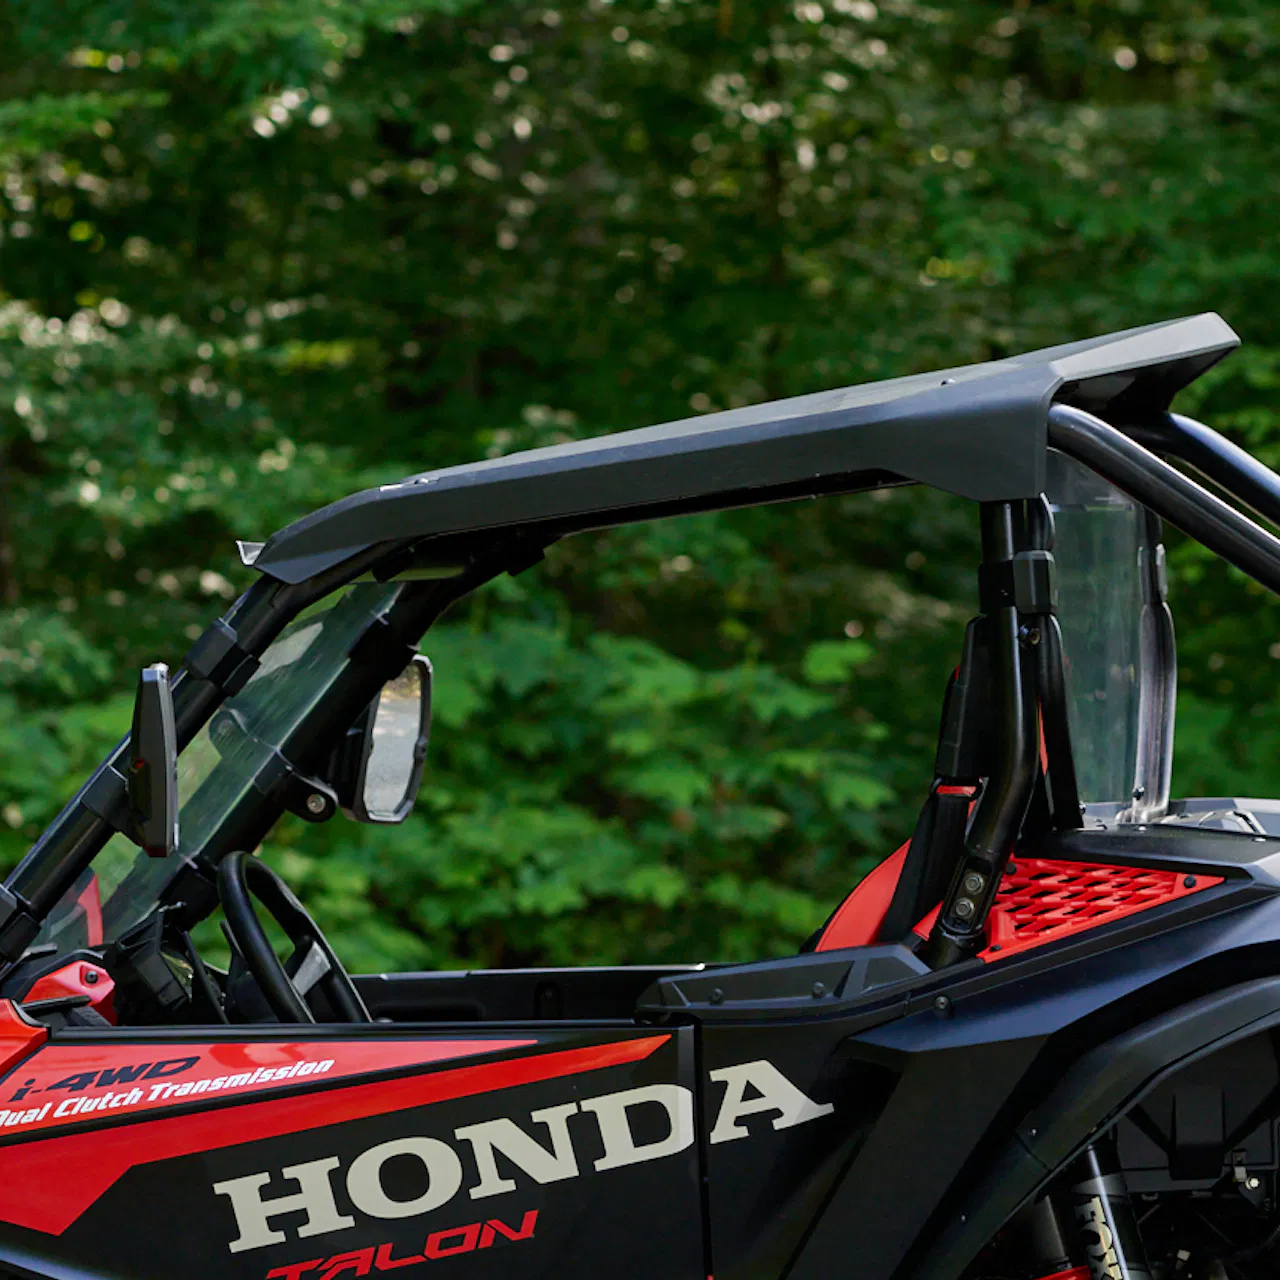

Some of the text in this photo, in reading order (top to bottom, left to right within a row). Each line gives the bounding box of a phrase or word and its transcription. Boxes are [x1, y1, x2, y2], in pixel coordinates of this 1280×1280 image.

[52, 1086, 145, 1120] Clutch
[148, 1059, 335, 1102] Transmission
[213, 1059, 835, 1254] HONDA
